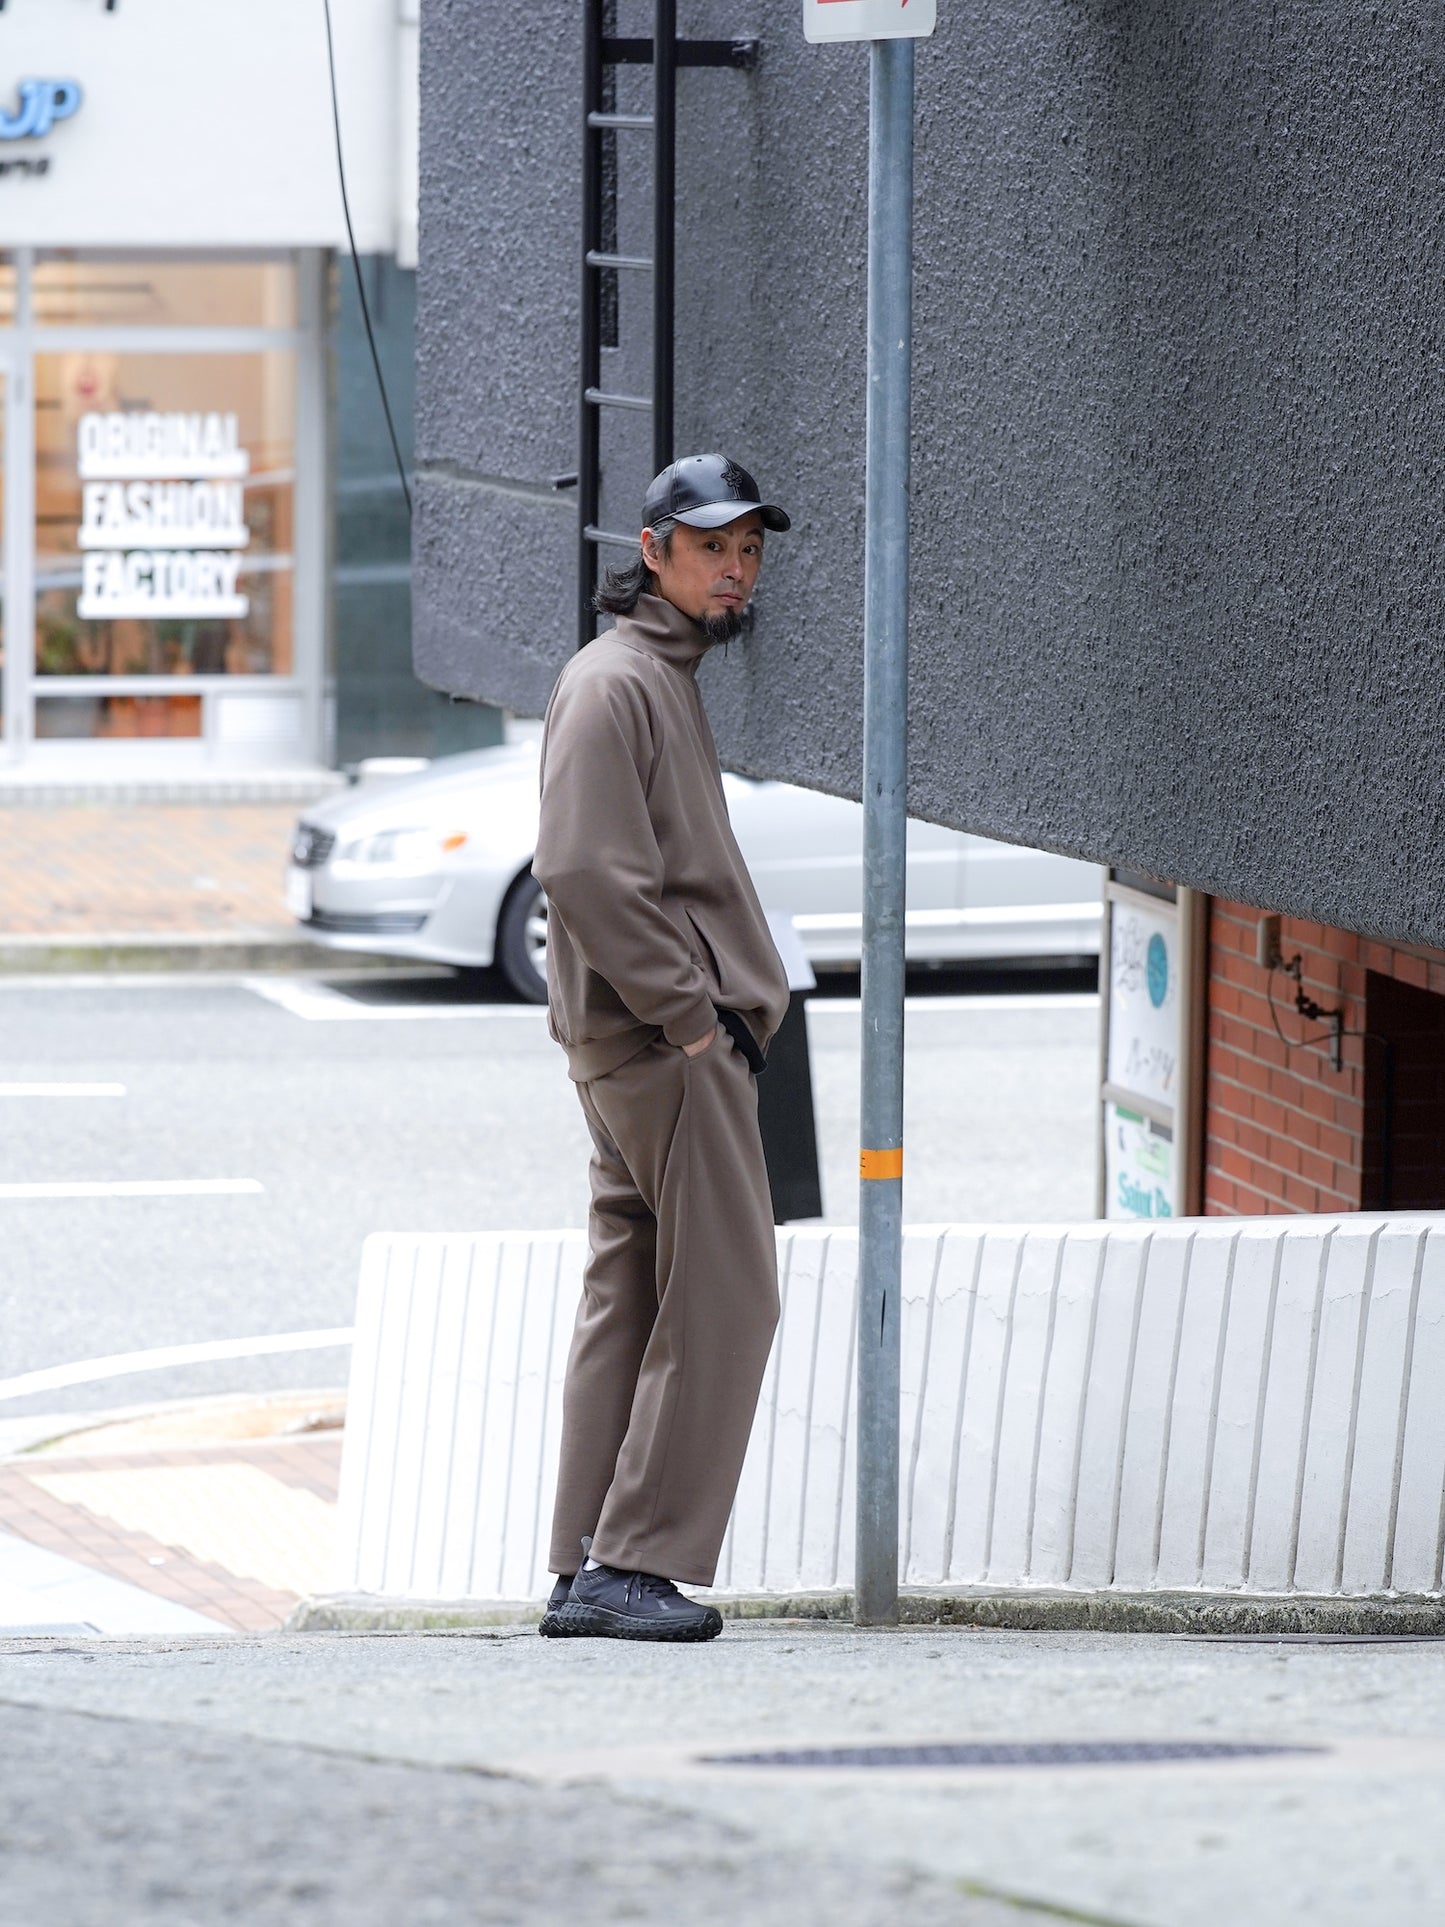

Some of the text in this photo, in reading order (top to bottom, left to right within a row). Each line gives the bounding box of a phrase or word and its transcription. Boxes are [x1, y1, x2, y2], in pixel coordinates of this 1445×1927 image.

[79, 412, 240, 459] ORIGINAL
[82, 481, 245, 528] FASHION
[82, 550, 243, 597] FACTORY
